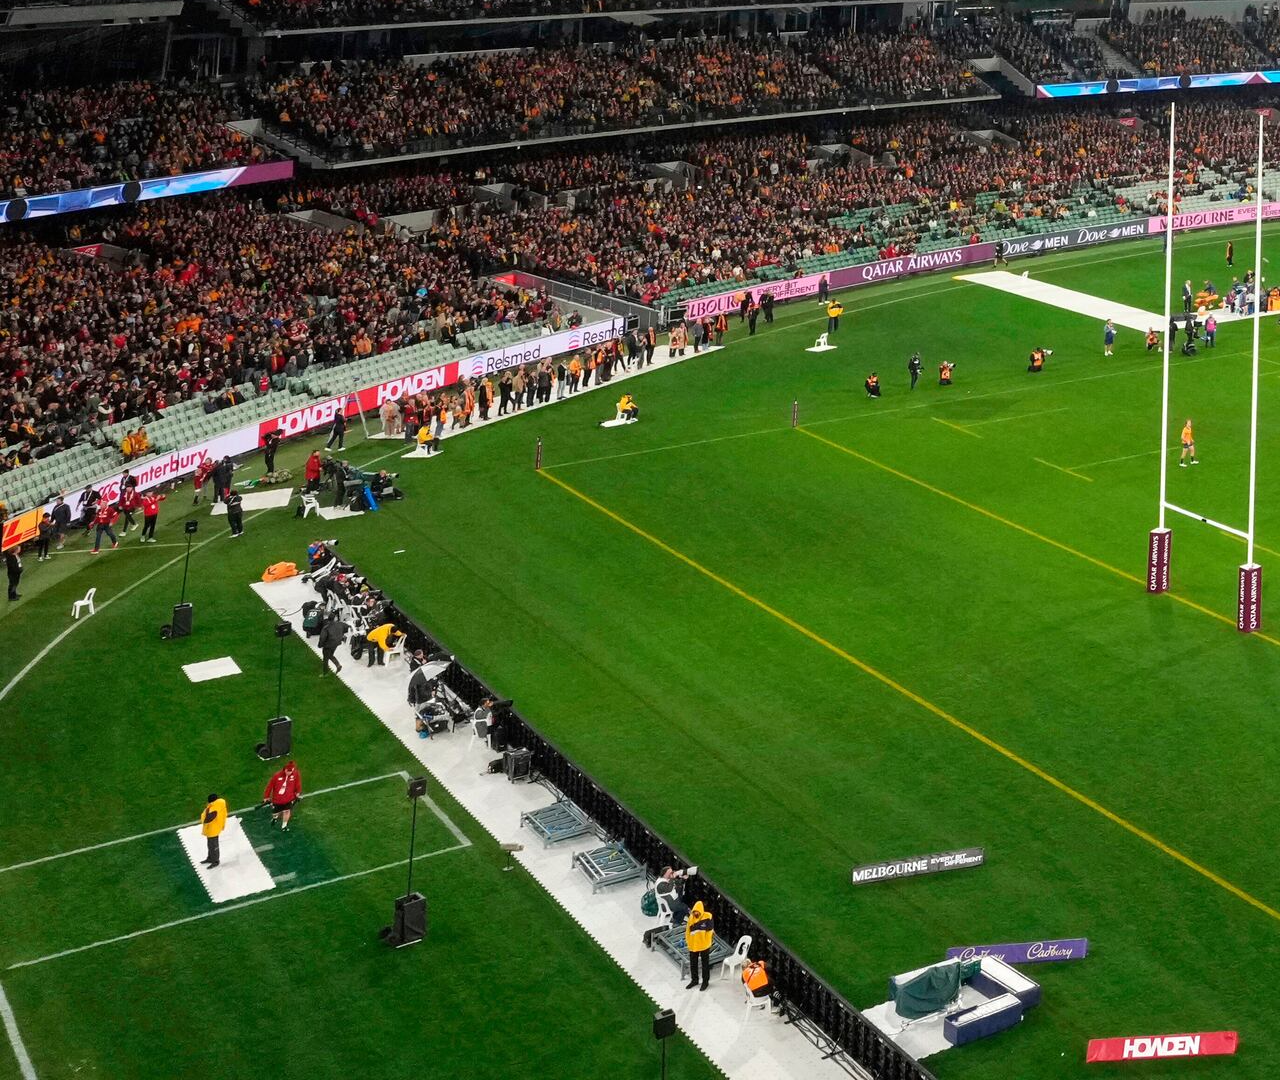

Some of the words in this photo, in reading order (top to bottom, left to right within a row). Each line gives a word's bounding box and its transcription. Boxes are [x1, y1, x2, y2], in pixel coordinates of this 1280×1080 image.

[1045, 235, 1069, 249] MEN
[1076, 228, 1108, 244] Dove
[1121, 223, 1144, 237] MEN
[862, 258, 903, 281] QATAR
[909, 249, 962, 273] AIRWAYS
[583, 324, 626, 346] Resme
[486, 345, 541, 370] Resmed
[377, 365, 445, 407] HOWDEN
[134, 448, 209, 488] anterbury
[853, 860, 928, 882] MELBOURNE
[930, 854, 955, 865] EVERY
[954, 853, 967, 861] BIT
[944, 855, 983, 867] DIFFERENT
[1026, 941, 1073, 960] Cadbury
[1122, 1035, 1201, 1059] HOWDEN
